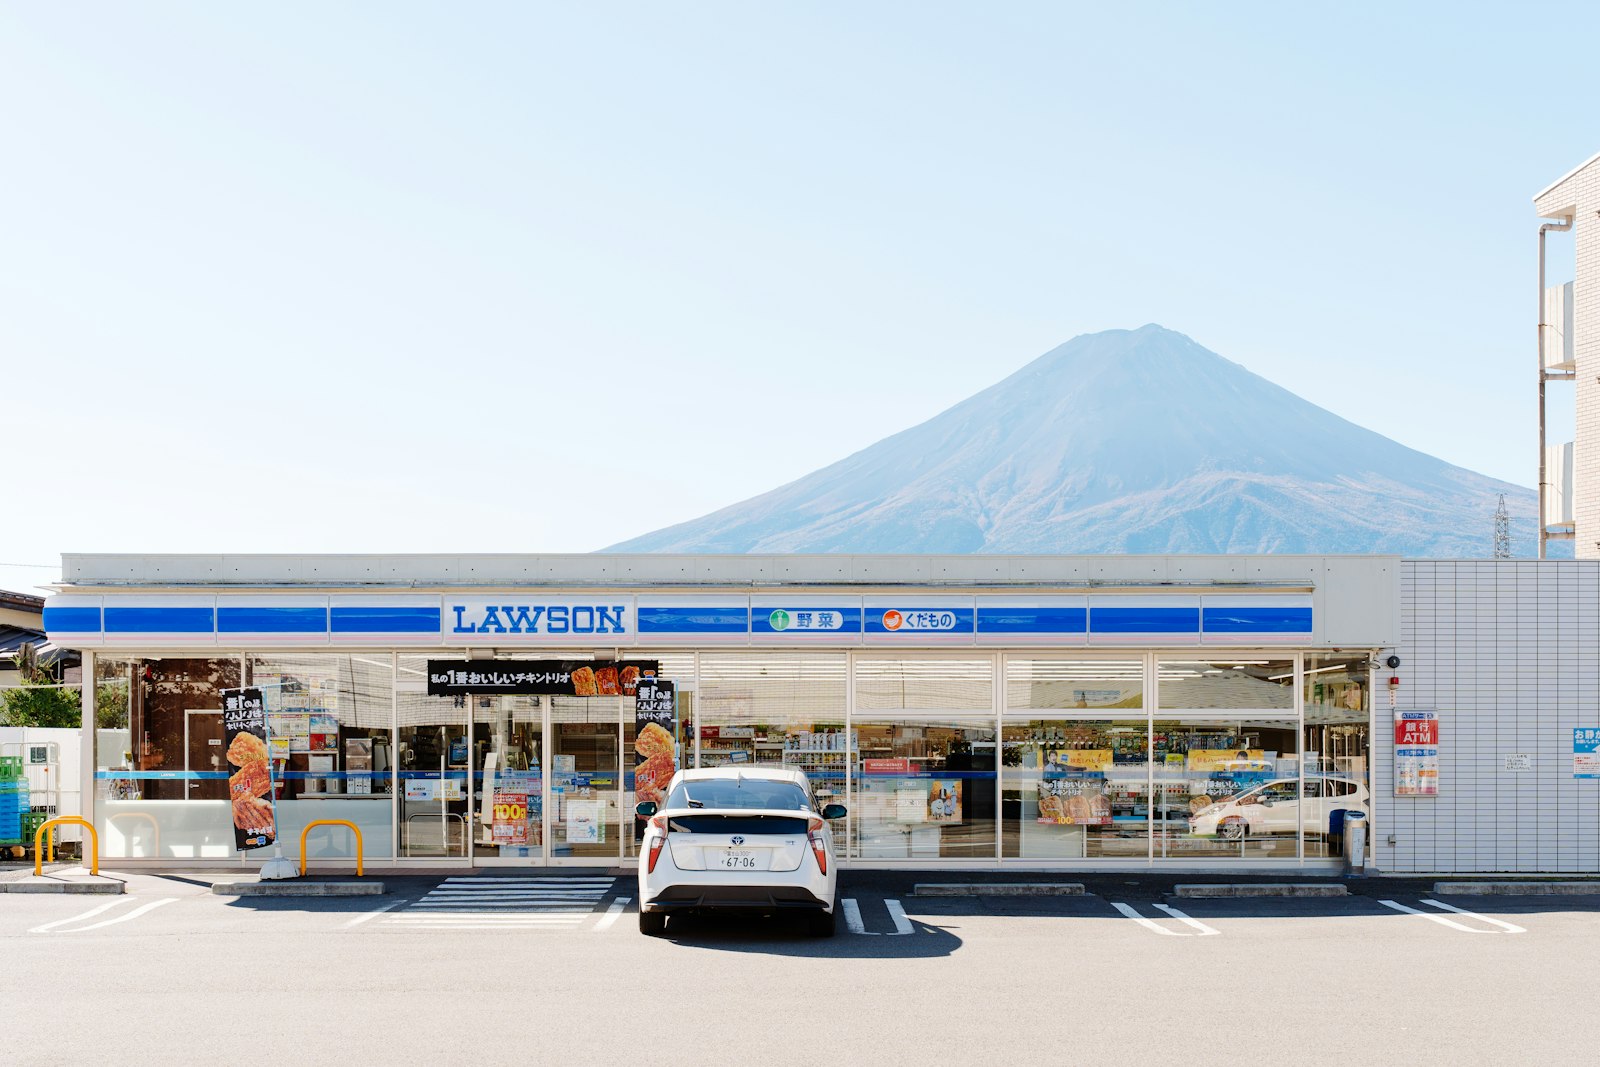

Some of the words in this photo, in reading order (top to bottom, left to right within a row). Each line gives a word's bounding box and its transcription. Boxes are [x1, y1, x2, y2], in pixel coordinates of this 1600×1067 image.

[453, 606, 625, 633] LAWSON
[797, 613, 834, 628] 野菜
[905, 613, 952, 628] くだもの
[430, 669, 571, 684] 私の1番おいしいチキントリオ
[1405, 722, 1430, 732] 銀行
[1403, 733, 1431, 743] ATM
[726, 857, 755, 867] 67-06
